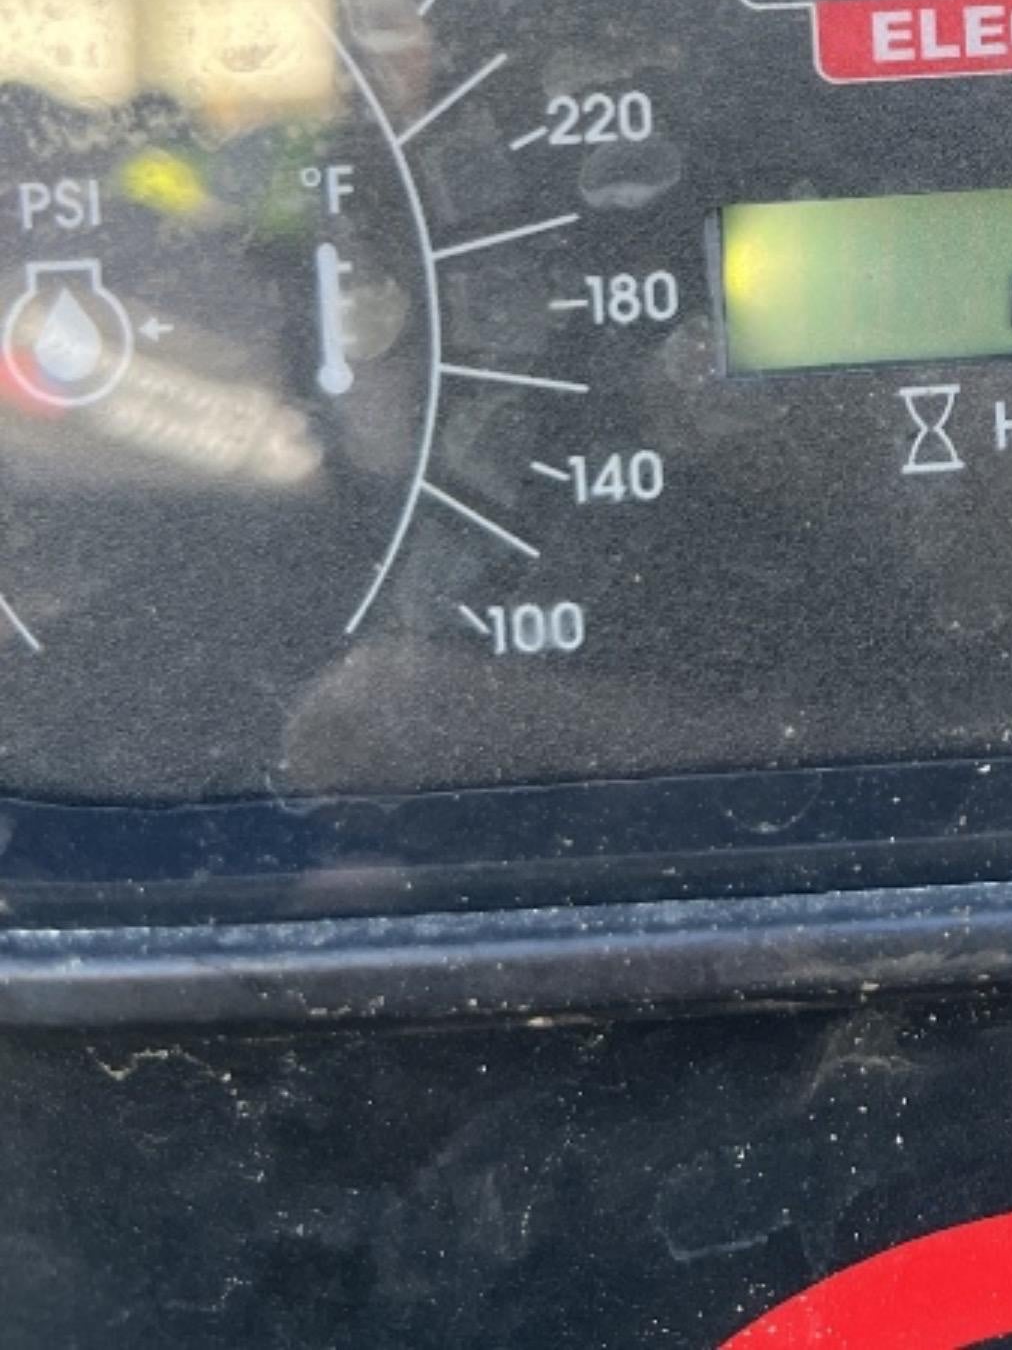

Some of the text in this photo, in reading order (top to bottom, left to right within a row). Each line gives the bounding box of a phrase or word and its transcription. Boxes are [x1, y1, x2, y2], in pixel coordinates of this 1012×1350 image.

[546, 90, 653, 147] 220
[19, 180, 102, 230] PSI
[586, 271, 679, 324] 180
[568, 453, 665, 504] 140
[488, 602, 585, 655] 100
